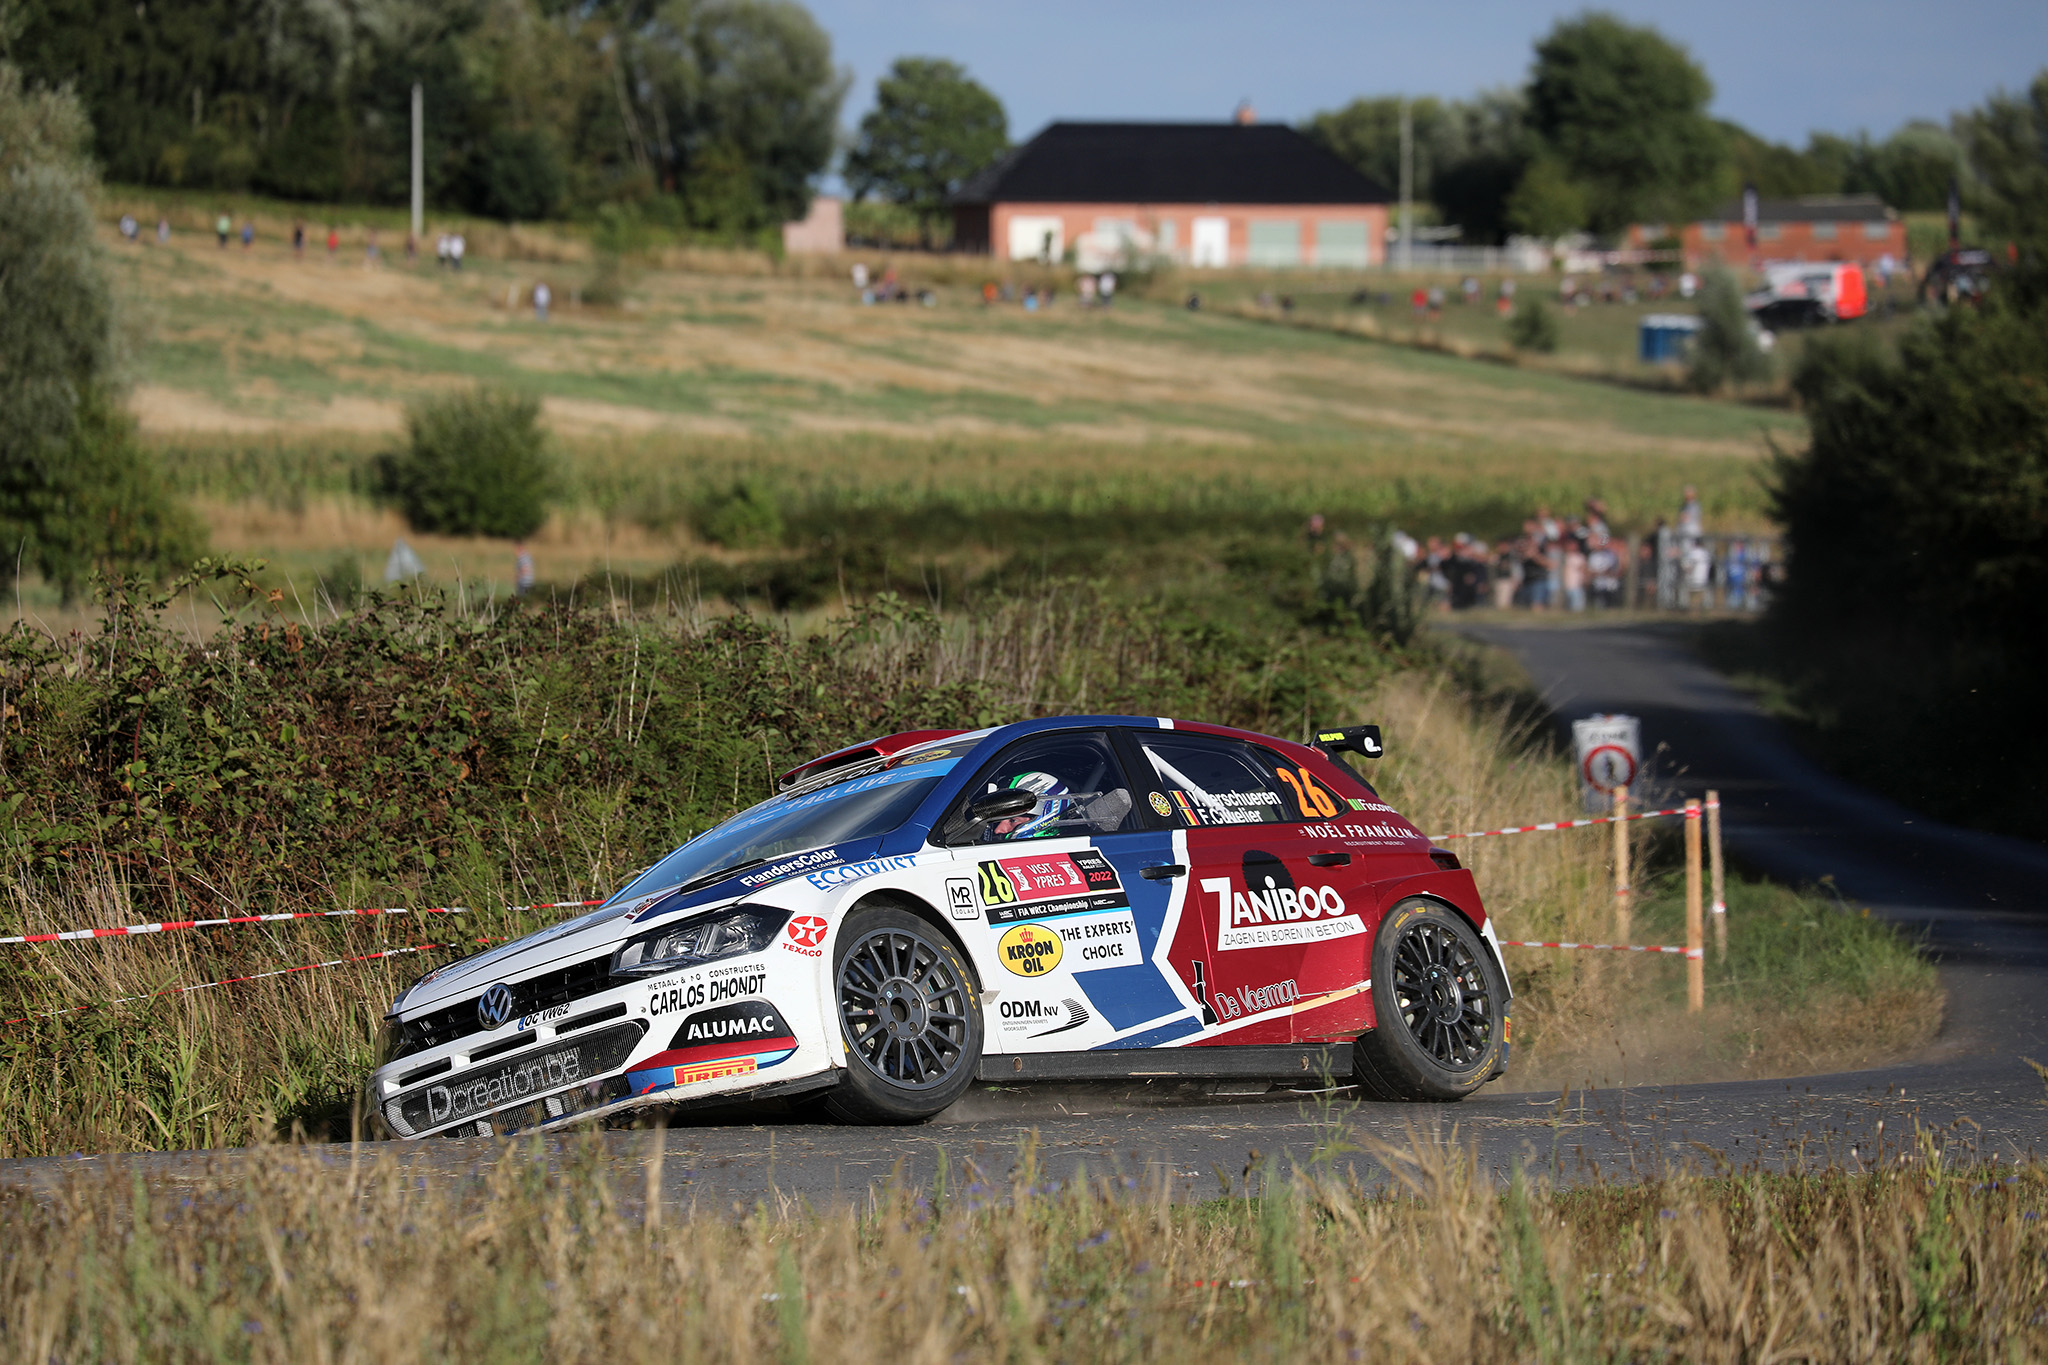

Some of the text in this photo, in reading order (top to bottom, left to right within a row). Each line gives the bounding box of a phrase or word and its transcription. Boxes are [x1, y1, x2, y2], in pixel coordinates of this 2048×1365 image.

[844, 773, 897, 793] LIVE
[1276, 767, 1338, 818] 26
[1303, 822, 1346, 838] NOËL
[739, 849, 838, 887] FlandersColor
[1026, 862, 1055, 875] VISIT
[1077, 858, 1103, 866] YPRES
[978, 862, 1015, 906] 26
[1033, 874, 1066, 889] YPRES
[1088, 871, 1113, 883] 2022
[951, 886, 971, 904] MR
[1017, 907, 1030, 917] FIA
[1029, 904, 1049, 915] WRC2
[1047, 900, 1090, 914] Championship
[1060, 927, 1082, 942] THE
[1224, 921, 1355, 946] ZAGEN EN BOREN IN BETON
[783, 942, 823, 957] TEXACO
[1007, 940, 1054, 961] KROON
[1082, 943, 1124, 960] CHOICE
[708, 963, 766, 979] CONSTRUCTIES
[1023, 957, 1045, 974] OIL
[650, 973, 767, 1016] CARLOS DHONDT
[1215, 978, 1301, 1020] De Voerman
[541, 1002, 572, 1022] VW62
[1001, 1000, 1059, 1018] ODM NV
[687, 1015, 774, 1041] ALUMAC
